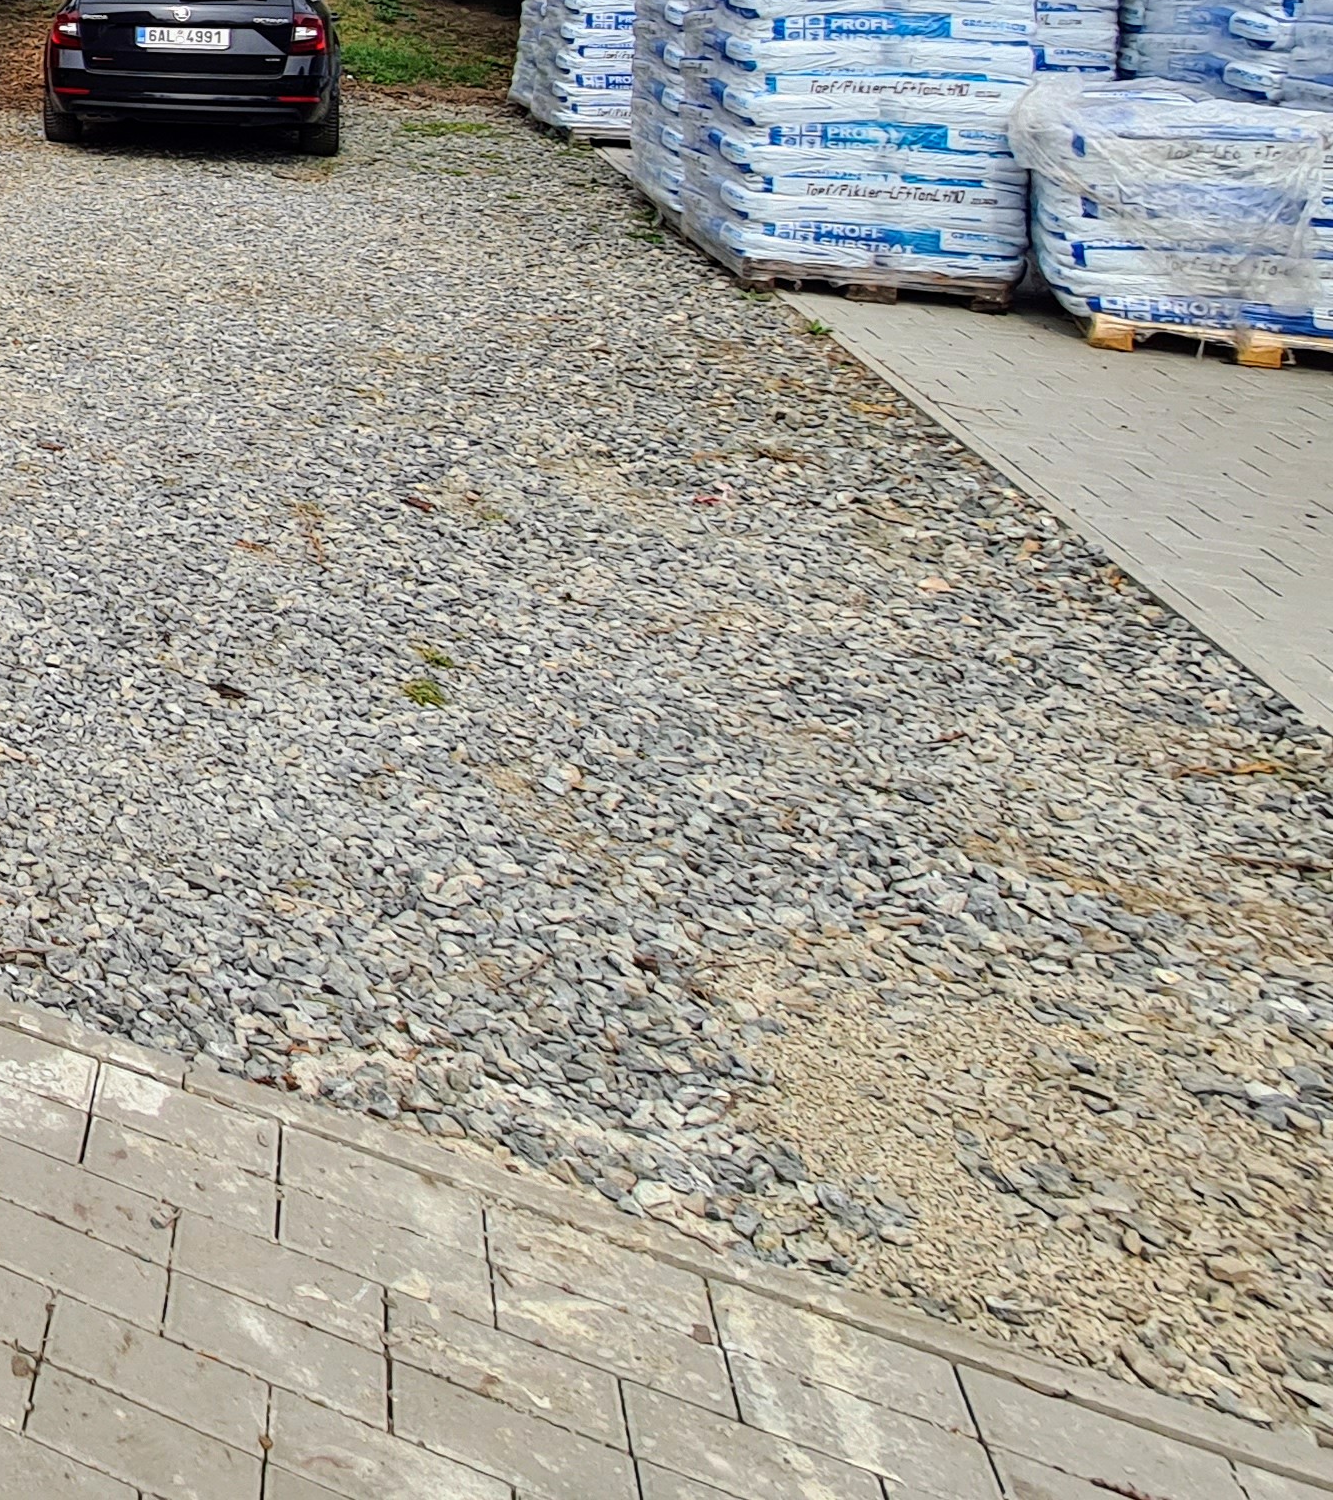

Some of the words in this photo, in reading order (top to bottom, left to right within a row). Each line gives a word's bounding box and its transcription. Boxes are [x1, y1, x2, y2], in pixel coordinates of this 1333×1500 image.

[148, 30, 176, 43] 6AL
[186, 30, 222, 44] 4991
[819, 224, 883, 240] PROFI-
[818, 238, 916, 255] SUBSTRAT
